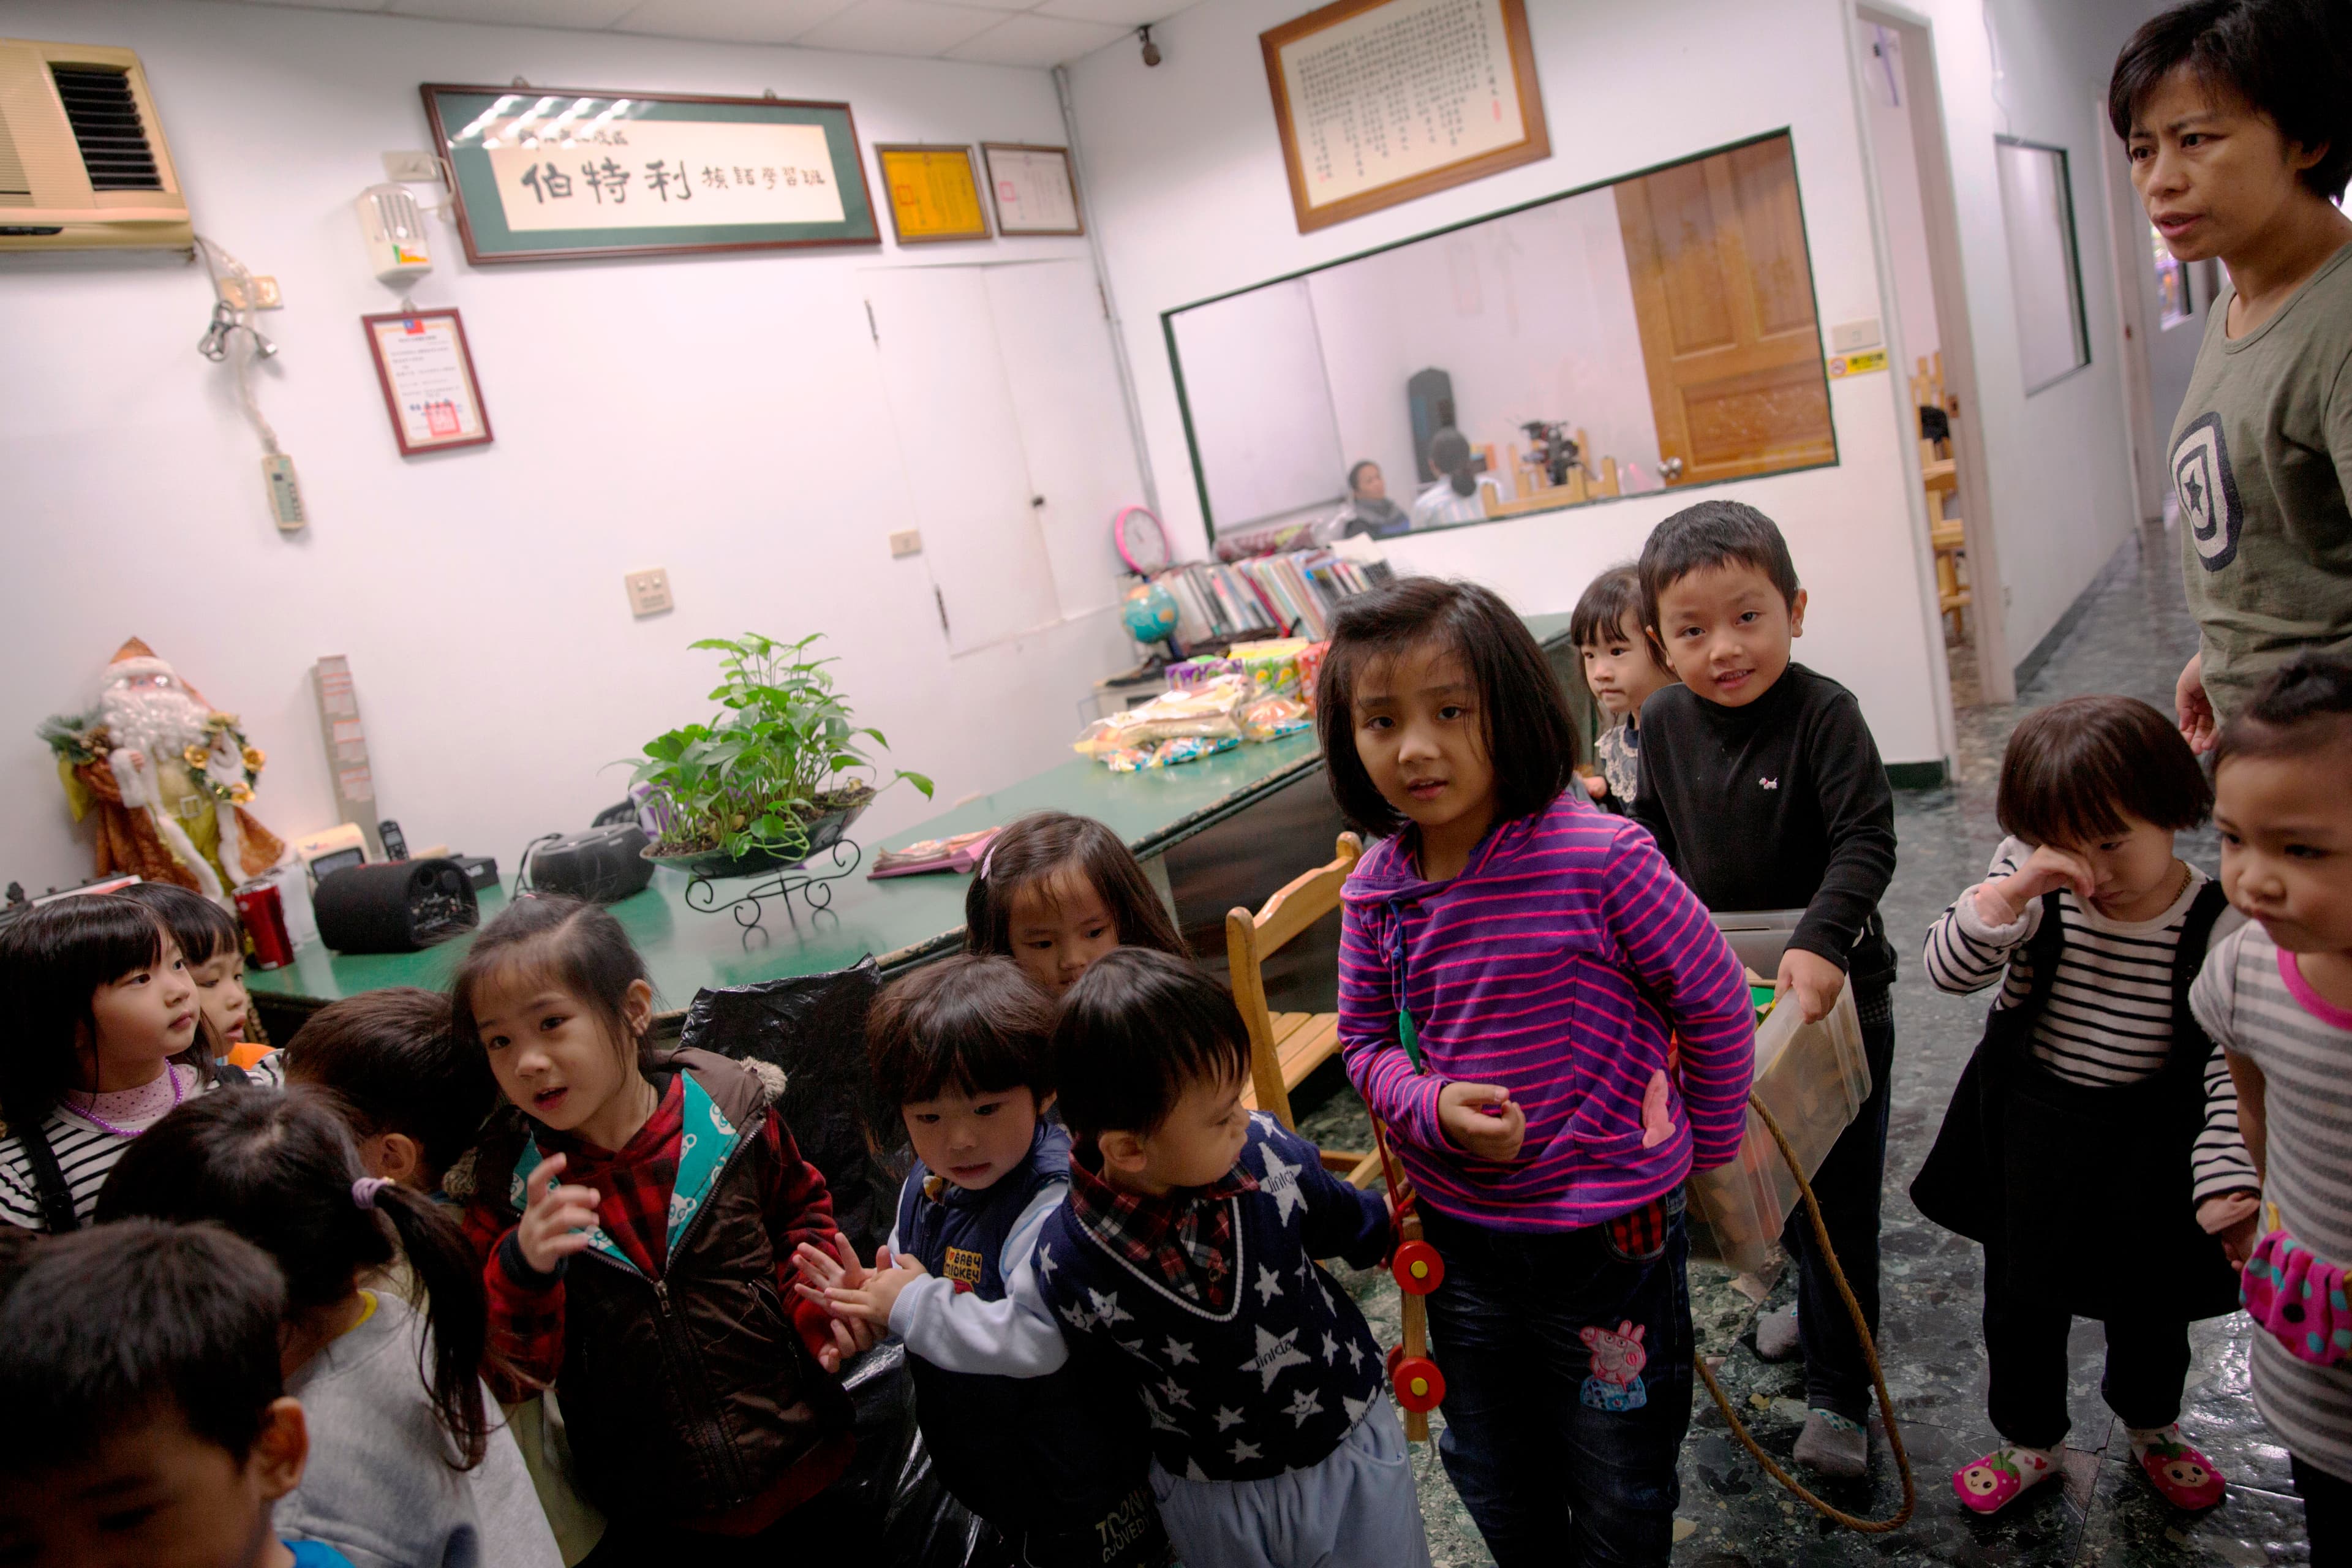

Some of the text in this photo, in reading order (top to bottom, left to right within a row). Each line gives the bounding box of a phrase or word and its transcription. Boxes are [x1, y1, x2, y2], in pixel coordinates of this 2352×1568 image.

[521, 156, 692, 205] 伯特利
[954, 1252, 981, 1268] BABY
